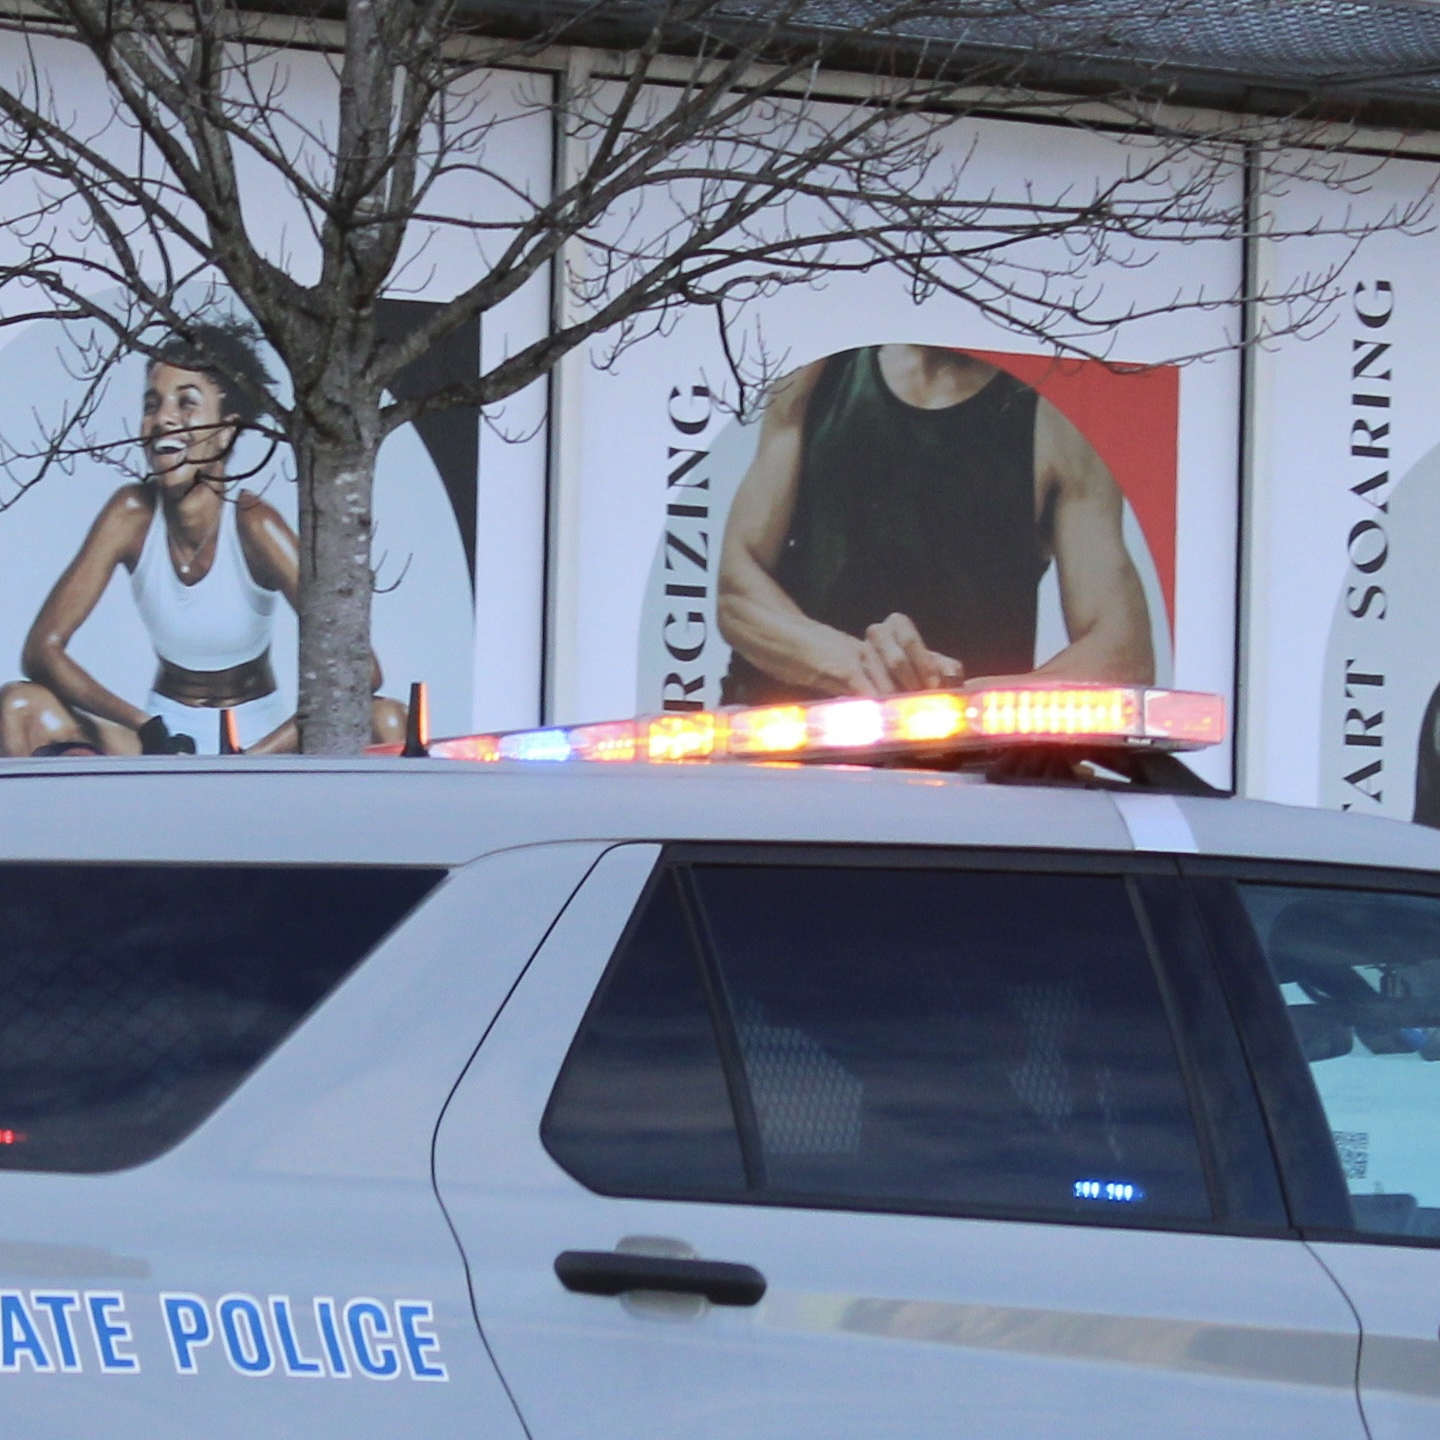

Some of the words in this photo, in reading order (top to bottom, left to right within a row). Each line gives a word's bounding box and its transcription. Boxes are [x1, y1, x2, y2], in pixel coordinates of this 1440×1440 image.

[1346, 279, 1395, 621] SOARING
[1342, 659, 1386, 812] ART
[159, 1291, 450, 1382] POLICE
